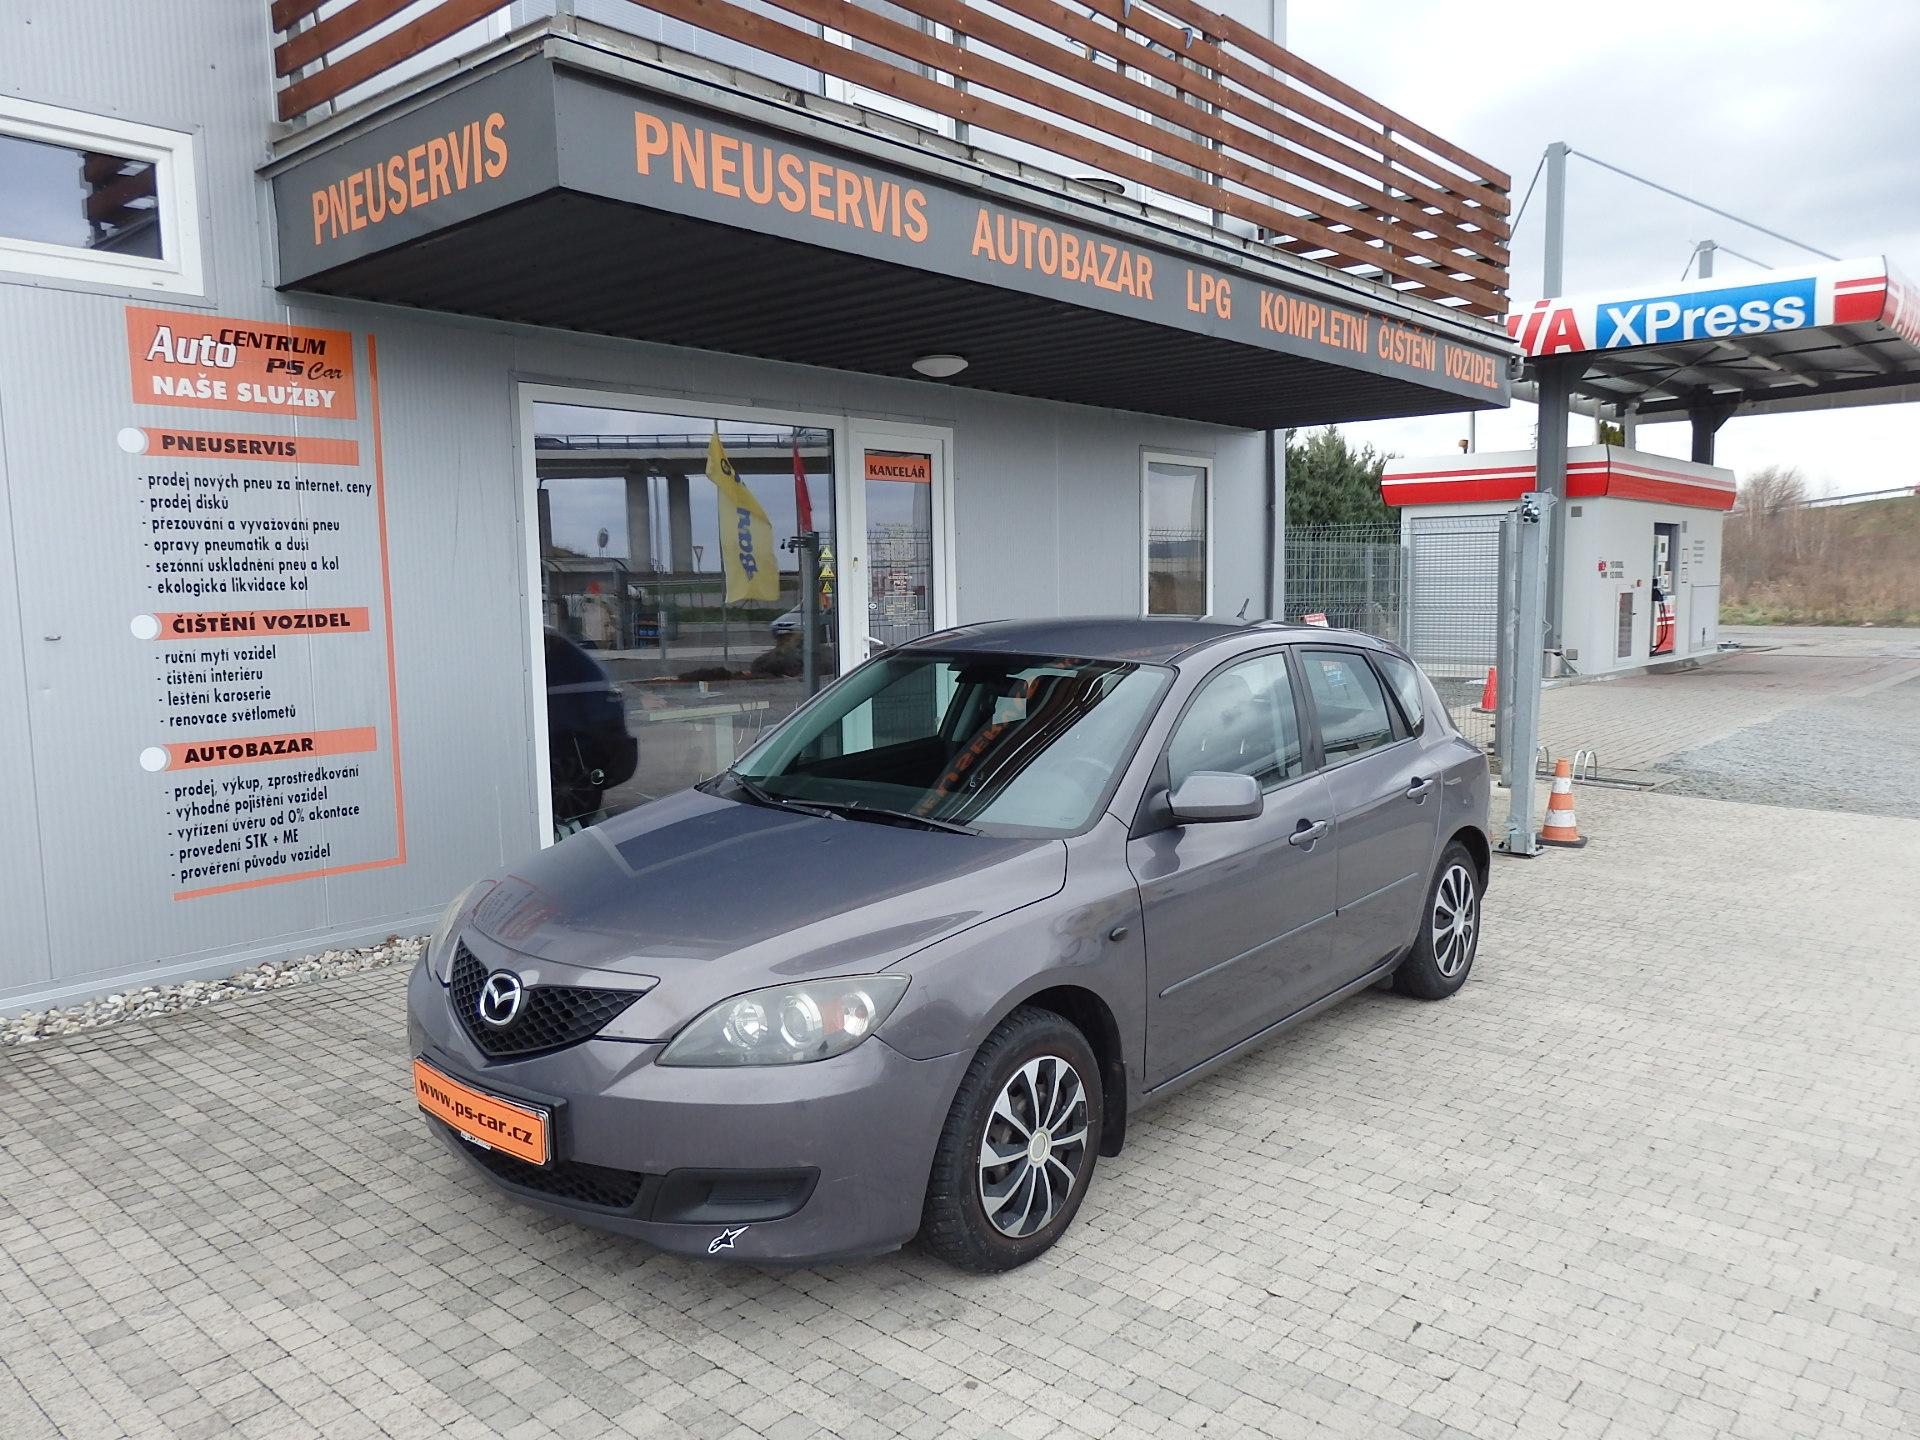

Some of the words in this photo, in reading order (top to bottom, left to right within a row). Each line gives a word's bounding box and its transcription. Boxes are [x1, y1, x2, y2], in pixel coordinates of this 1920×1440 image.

[312, 111, 508, 245] PNEUSERVIS
[634, 110, 928, 243] PNEUSERVIS
[971, 208, 1154, 301] AUTOBAZAR
[1186, 268, 1231, 320] LPG
[1259, 290, 1370, 353] KOMPLETNÍ
[1377, 315, 1437, 372] ČIŠTĚNÍ
[1444, 344, 1499, 390] VOZIDEL
[1606, 296, 1806, 349] XPress
[145, 325, 238, 369] Auto
[219, 328, 326, 356] CENTRUM
[266, 358, 304, 376] PS
[307, 361, 344, 380] Car
[152, 372, 228, 400] NAŠE
[237, 381, 336, 408] SLUŽBY
[162, 434, 297, 457] PNEUSERVIS
[869, 463, 925, 478] KANCELÁŘ
[148, 473, 190, 494] prodej
[194, 473, 239, 493] nových
[244, 478, 272, 493] pneu
[277, 479, 290, 491] za
[295, 475, 343, 493] internet.
[346, 482, 372, 497] ceny
[150, 494, 192, 513] prodej
[196, 494, 229, 510] disků
[152, 516, 223, 536] přezouvání
[228, 521, 235, 531] a
[240, 517, 309, 536] vyvažování
[313, 520, 340, 535] pneu
[154, 540, 199, 556] opravy
[204, 536, 269, 553] pneumatik
[274, 541, 282, 551] a
[156, 558, 203, 574] sezónní
[208, 556, 275, 572] uskladnění
[278, 560, 307, 575] pneu
[311, 561, 318, 571] a
[322, 555, 339, 571] kol
[157, 576, 226, 597] ekologická
[231, 574, 286, 592] likvidace
[291, 575, 308, 590] kol
[172, 611, 256, 633] ČIŠTĚNÍ
[263, 612, 351, 630] VOZIDEL
[165, 648, 196, 664] ruční
[233, 645, 277, 661] vozidel
[166, 668, 207, 685] čištění
[210, 667, 263, 682] interiéru
[167, 690, 210, 706] leštění
[213, 687, 271, 703] karoserie
[169, 712, 227, 727] renovace
[231, 705, 297, 723] světlometů
[184, 737, 314, 763] AUTOBAZAR
[174, 778, 218, 800] prodej,
[267, 764, 360, 791] zprostředkování
[176, 796, 230, 821] výhodné
[235, 792, 284, 814] pojištění
[287, 786, 328, 803] vozidel
[177, 818, 228, 841] vyřízení
[232, 813, 266, 830] úvěru
[270, 808, 284, 826] od
[288, 807, 305, 824] 0%
[309, 802, 360, 821] akontace
[178, 840, 241, 863] provedení
[245, 832, 268, 849] STK
[283, 828, 299, 844] ME
[181, 860, 241, 883] prověření
[245, 850, 287, 872] původu
[291, 843, 331, 862] vozidel
[419, 1079, 534, 1146] www.ps-car.cz
